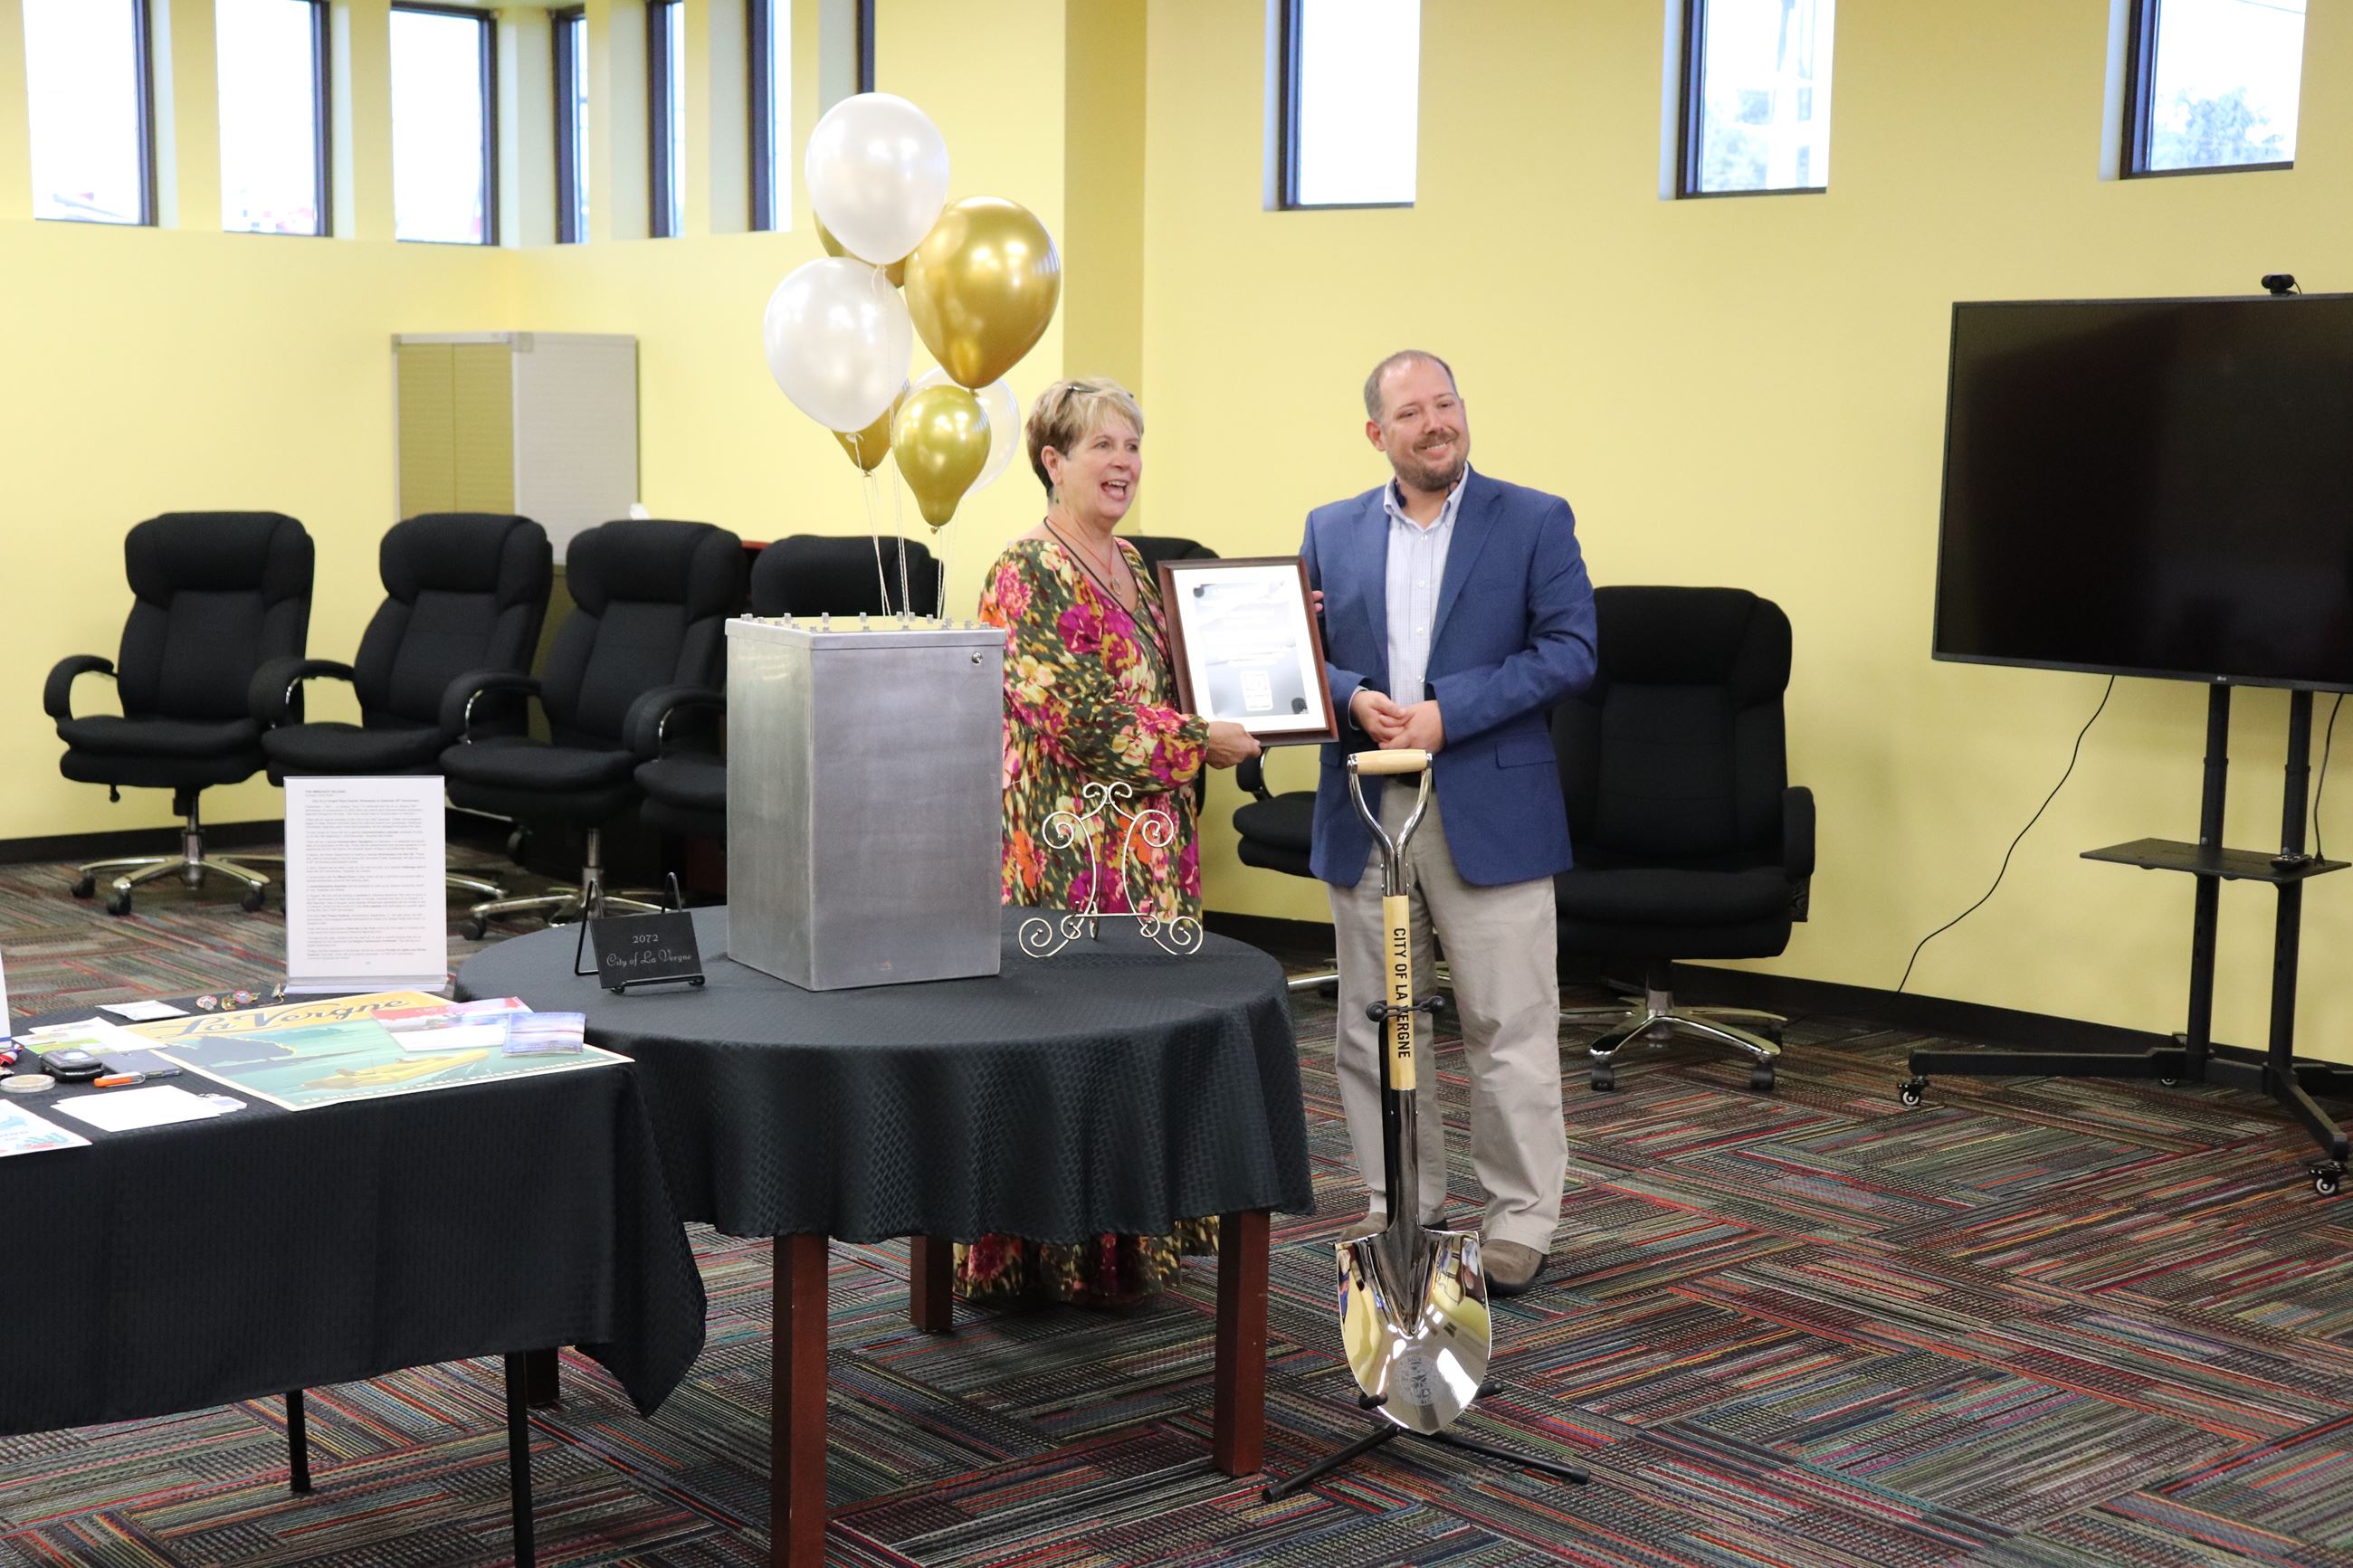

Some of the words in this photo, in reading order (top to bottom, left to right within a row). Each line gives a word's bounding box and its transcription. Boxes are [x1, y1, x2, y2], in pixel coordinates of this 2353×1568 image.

[632, 934, 659, 944] 2072
[1394, 927, 1406, 958] CITY
[607, 954, 627, 967] City
[629, 951, 638, 967] of
[639, 950, 657, 965] La
[659, 949, 691, 964] Vergne
[1395, 964, 1407, 979] OF
[1396, 984, 1408, 1001] LA
[147, 1016, 237, 1040] La
[233, 999, 412, 1028] Vergne
